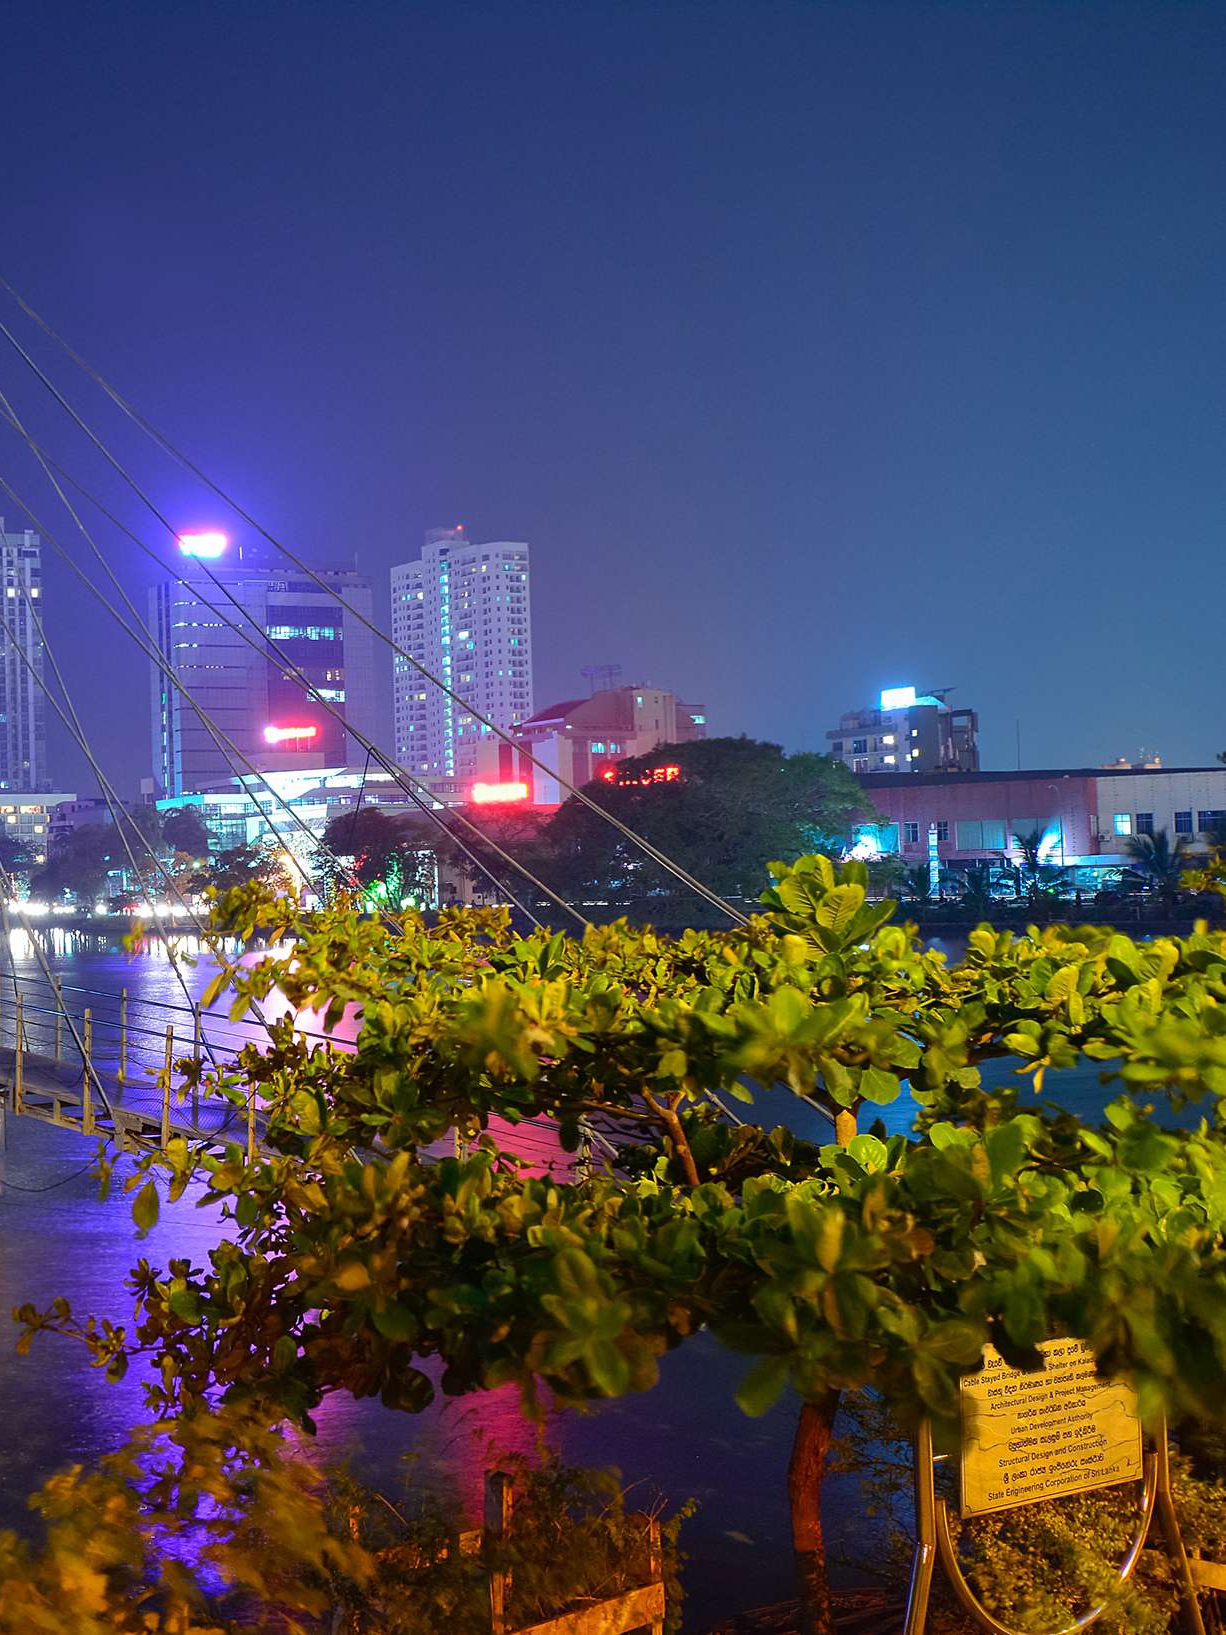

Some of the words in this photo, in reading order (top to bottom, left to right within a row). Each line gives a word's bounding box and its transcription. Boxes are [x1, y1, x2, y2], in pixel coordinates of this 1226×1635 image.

[964, 1378, 979, 1387] Cable
[981, 1374, 1000, 1384] Stayed
[1002, 1369, 1021, 1380] Bridge
[990, 1397, 1027, 1411] Architectural
[1028, 1393, 1048, 1403] Design
[1055, 1387, 1075, 1398] Project
[1076, 1379, 1112, 1394] Management
[1011, 1425, 1028, 1435] Urban
[1029, 1417, 1066, 1431] Development
[1067, 1411, 1094, 1425] Authority
[998, 1453, 1030, 1468] Structural
[1031, 1450, 1053, 1461] Design
[1054, 1446, 1067, 1456] and
[1067, 1438, 1107, 1453] Construction
[988, 1491, 1004, 1501] State
[1006, 1483, 1044, 1497] Engineering
[1045, 1474, 1082, 1488] Corporation
